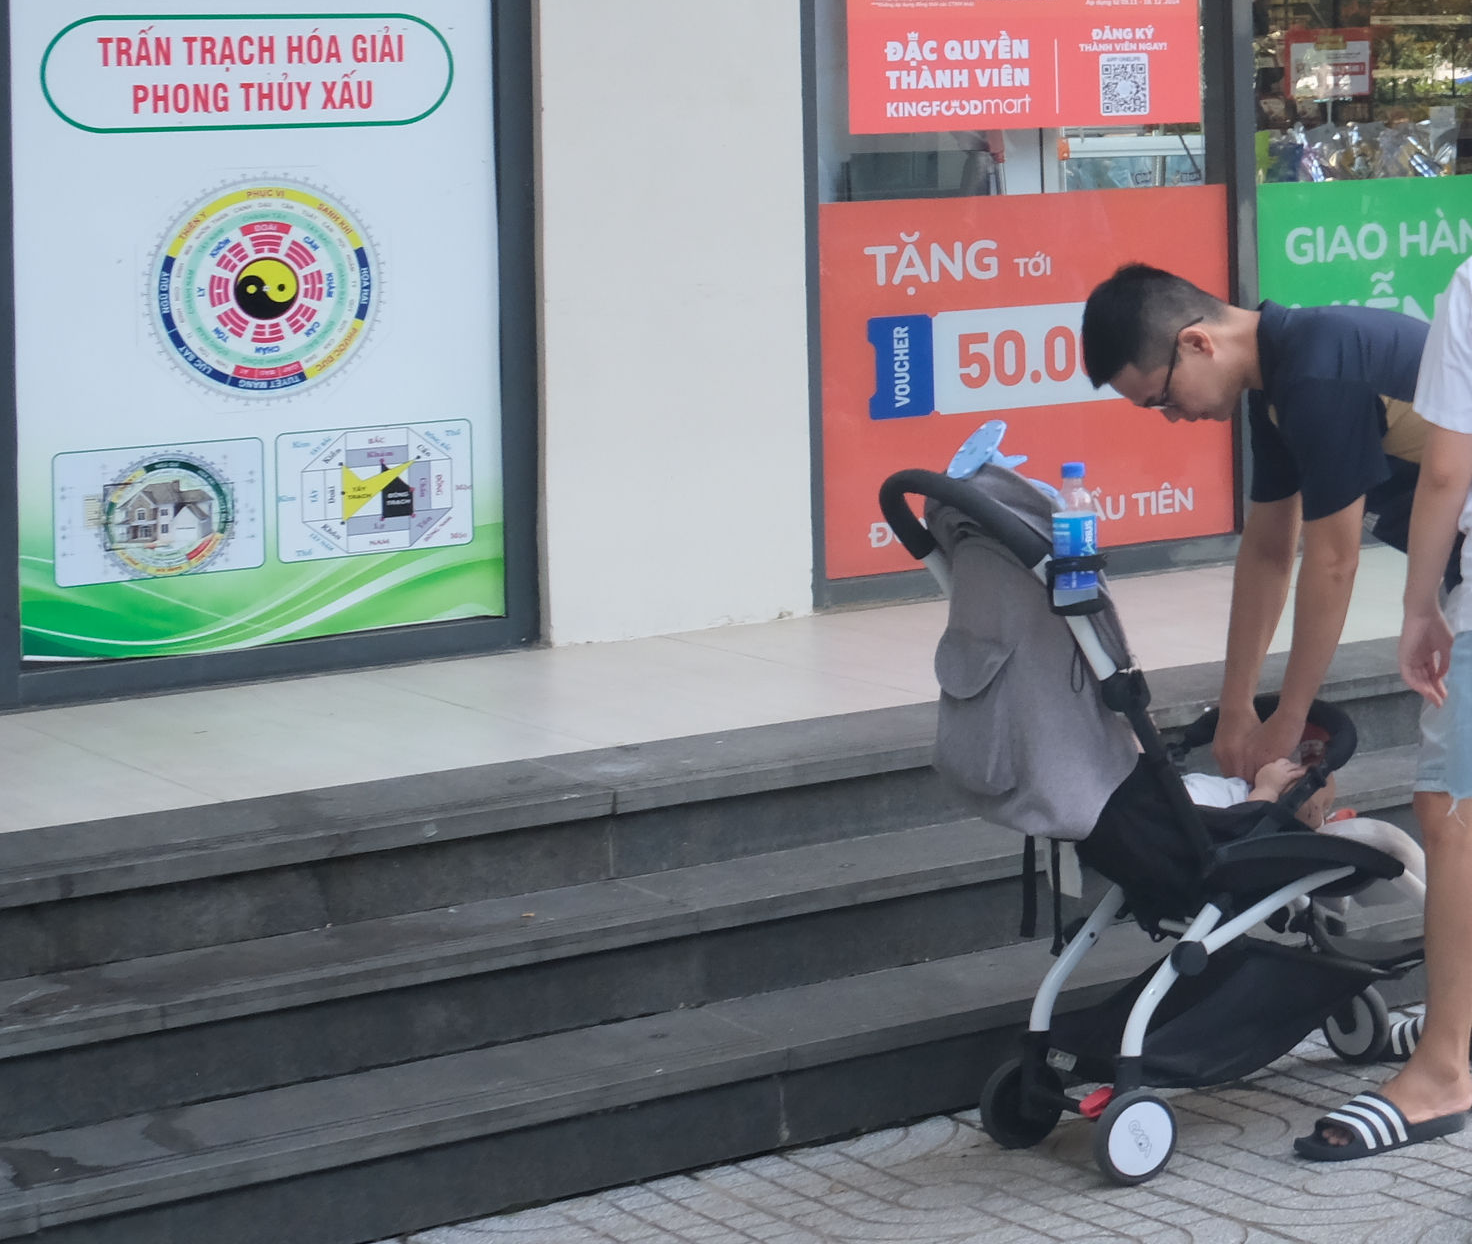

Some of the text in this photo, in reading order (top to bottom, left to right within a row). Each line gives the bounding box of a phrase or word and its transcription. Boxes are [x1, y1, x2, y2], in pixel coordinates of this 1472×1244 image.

[97, 25, 406, 76] TRẤN TRẠCH HÓA GIẢI
[885, 30, 1029, 67] ĐẶC QUYỀN
[1079, 42, 1112, 52] THÀNH
[1114, 41, 1137, 51] VIÊN
[1091, 25, 1154, 40] ĐĂNG KÝ
[131, 72, 374, 117] PHONG THỦY XẤU
[886, 64, 1030, 90] THÀNH VIÊN
[864, 231, 1051, 295] TẶNG TỚI
[1285, 223, 1388, 265] GIAO
[894, 326, 909, 408] VOUCHER
[1132, 482, 1194, 516] TIÊN
